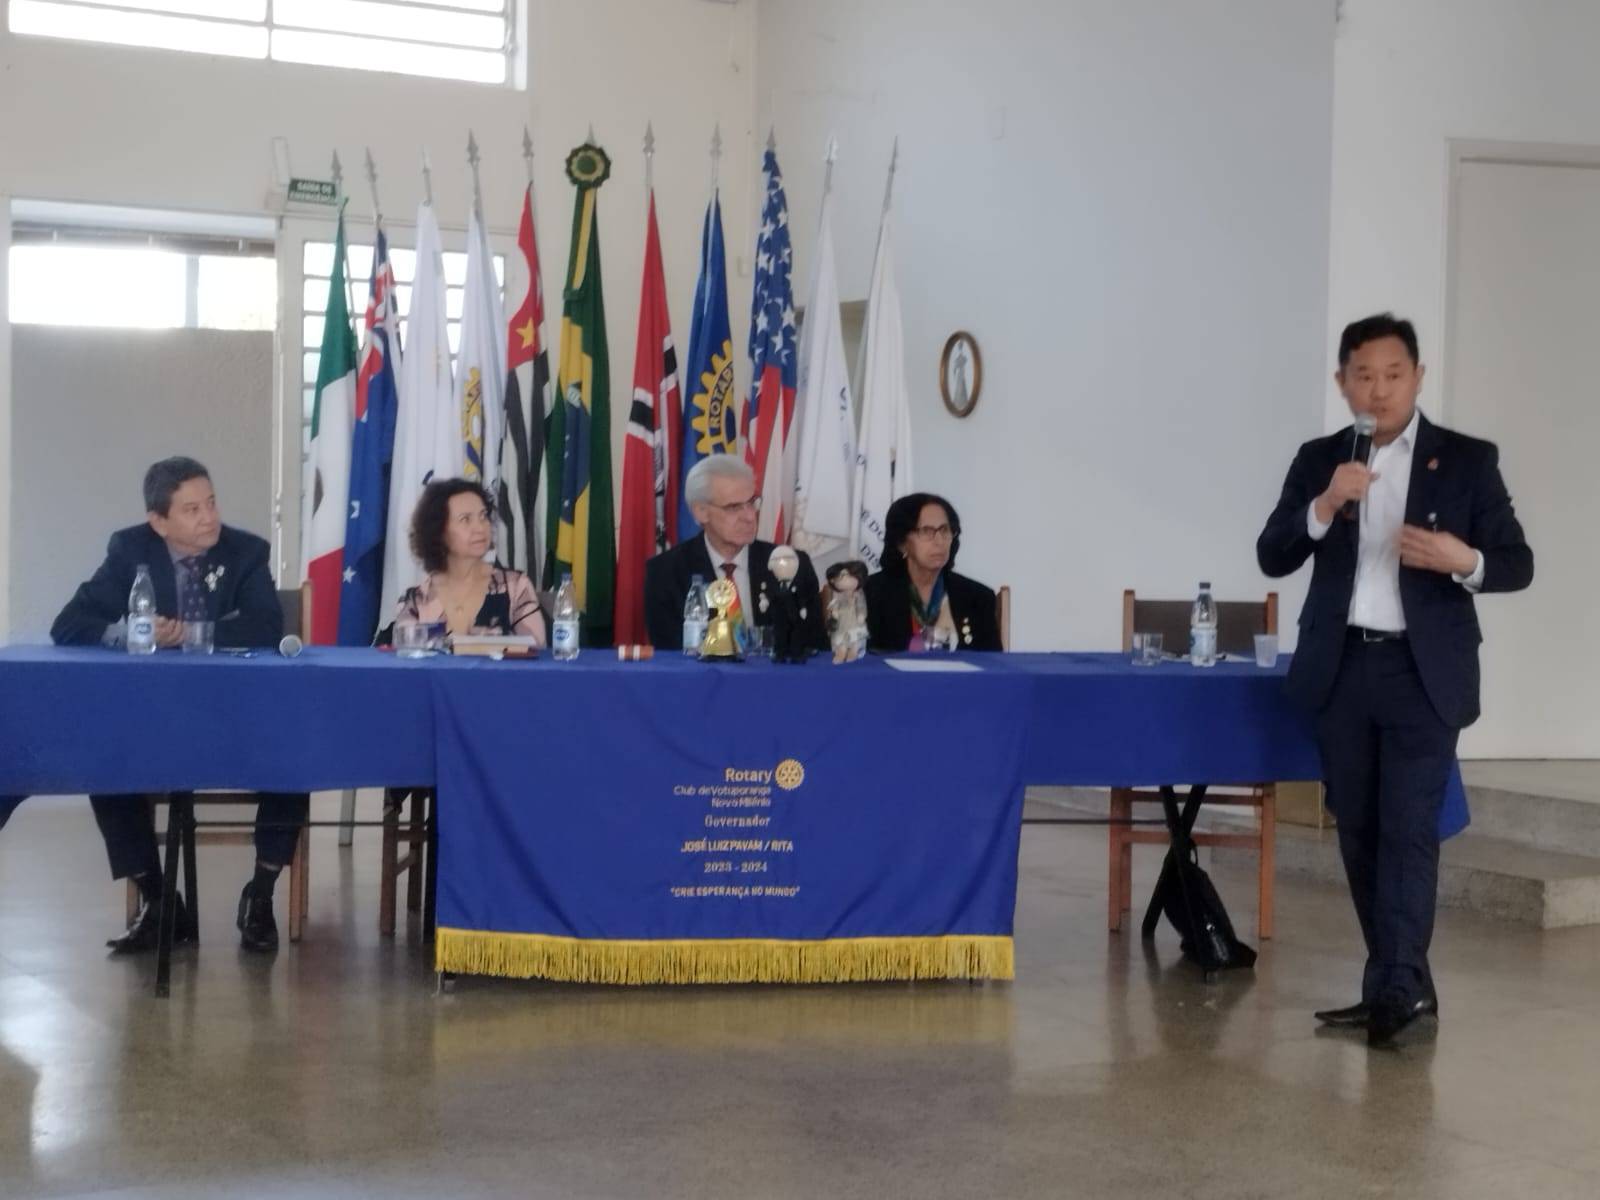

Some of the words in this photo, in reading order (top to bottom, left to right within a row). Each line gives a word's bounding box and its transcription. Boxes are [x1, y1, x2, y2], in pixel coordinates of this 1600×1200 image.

[725, 768, 772, 784] Rotary
[673, 785, 696, 796] Club
[704, 814, 770, 828] Governador
[680, 837, 707, 853] JOSÉ
[708, 840, 730, 852] LUIZ
[771, 840, 794, 853] RITA
[704, 861, 732, 873] 2023
[741, 861, 768, 873] 2024
[697, 887, 749, 899] ESPERANÇA
[751, 887, 763, 897] NO
